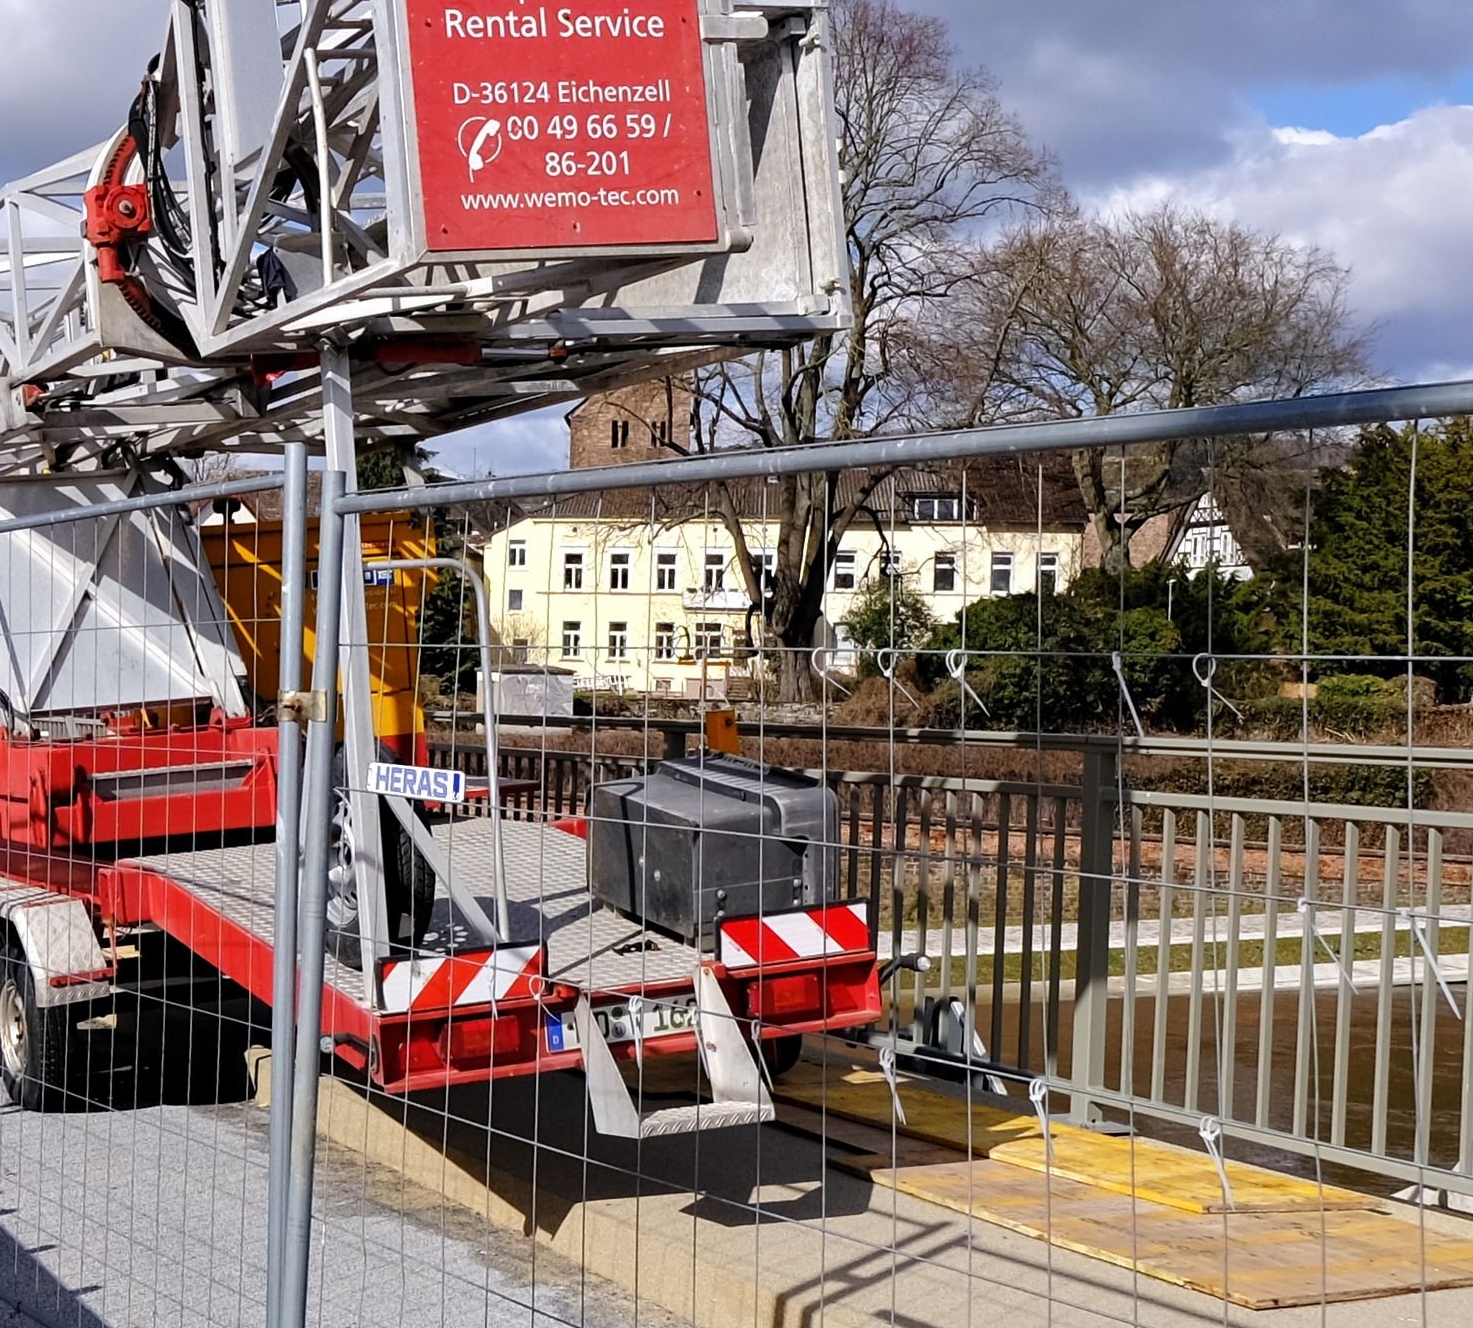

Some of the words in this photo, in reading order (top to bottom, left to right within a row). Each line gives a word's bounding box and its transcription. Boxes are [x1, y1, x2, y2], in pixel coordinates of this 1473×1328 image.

[444, 7, 547, 38] Rental
[557, 8, 665, 38] Service
[453, 81, 551, 105] D-36124
[557, 80, 671, 103] Eichenzell
[507, 116, 539, 141] 00
[546, 115, 578, 140] 49
[586, 114, 618, 139] 66
[626, 113, 656, 139] 59
[545, 151, 630, 177] 86-201
[461, 189, 680, 210] www.wemo-tec.com
[375, 765, 448, 799] HERAS
